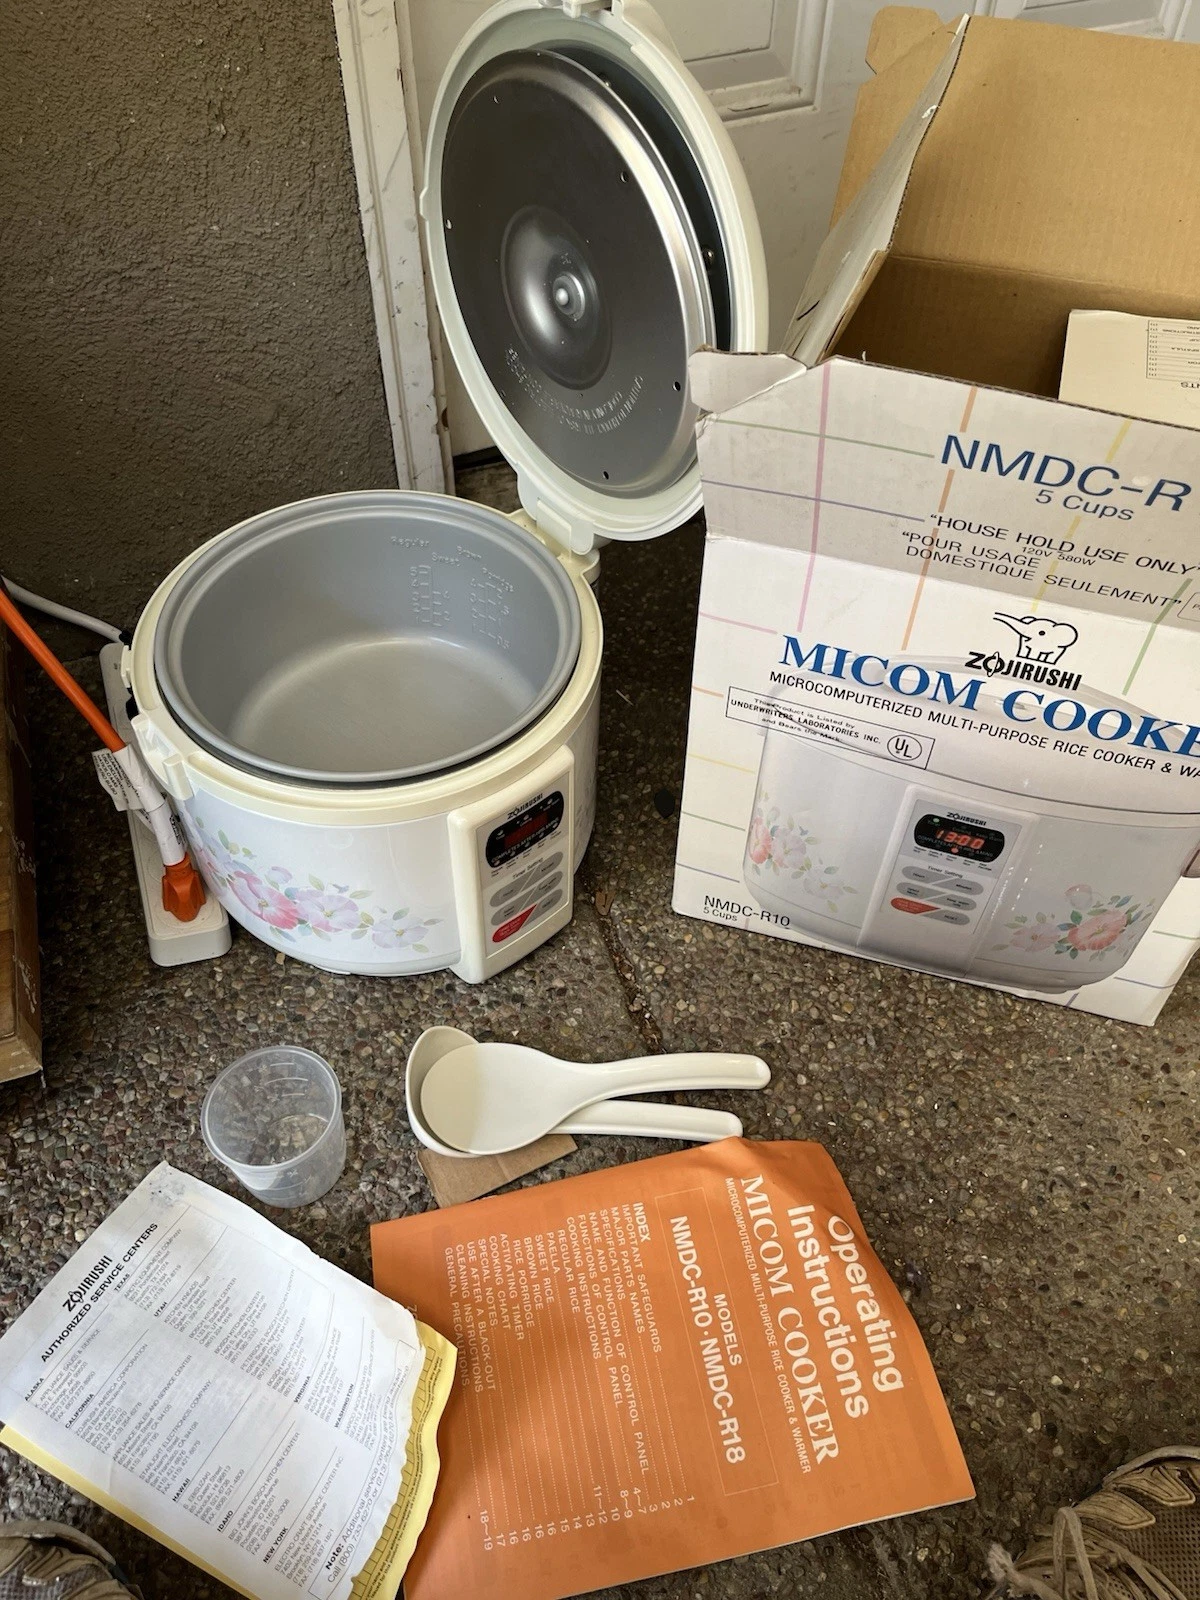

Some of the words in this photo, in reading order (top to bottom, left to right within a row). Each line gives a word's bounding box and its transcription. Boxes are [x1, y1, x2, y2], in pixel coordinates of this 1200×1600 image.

[941, 435, 1192, 512] NMDC-R
[1035, 490, 1052, 504] 5
[1063, 495, 1134, 521] Cups
[906, 545, 1035, 581] DOMESTIQUE
[972, 545, 1041, 568] USAGE
[1016, 532, 1075, 553] HOLD
[1085, 546, 1129, 563] USE
[1022, 547, 1052, 558] 120V
[1058, 554, 1096, 566] 580W
[778, 634, 987, 711] MICOM
[965, 651, 1082, 691] ZOJIRUSHI
[731, 700, 793, 720] UNDERWRITERS
[797, 717, 859, 738] LABORATORIES
[864, 735, 881, 744] INC.
[770, 671, 922, 718] MICROCOMPUTERIZED
[928, 711, 1049, 748] MULTI-PURPOSE
[1053, 740, 1088, 757] RICE
[1093, 749, 1156, 770] COOKER
[1161, 762, 1172, 774] &
[895, 738, 912, 758] UL
[507, 793, 543, 819] ZOJIRUSHI
[704, 895, 790, 926] NMDC-R10
[712, 909, 737, 921] Cups
[632, 1202, 650, 1242] INDEX
[724, 1177, 757, 1270] MICROCOMPUTERIZED
[466, 1241, 476, 1262] USE
[512, 1239, 523, 1264] RICE
[546, 1231, 560, 1273] PAELLA
[577, 1214, 597, 1278] FUNCTIONS
[39, 1302, 92, 1362] AUTHORIZED
[89, 1262, 124, 1302] SERVICE
[121, 1222, 158, 1263] CENTERS
[61, 1254, 113, 1312] ZOJIRUSHI
[113, 1273, 130, 1291] TEXAS
[470, 1266, 482, 1303] AFTER
[517, 1269, 534, 1327] PORRIDGE
[566, 1216, 583, 1267] COOKING
[577, 1272, 601, 1359] INSTRUCTIONS
[591, 1283, 601, 1299] OF
[621, 1204, 642, 1269] IMPORTANT
[637, 1274, 661, 1352] SAFEGUARDS
[153, 1301, 167, 1317] UTAH
[444, 1247, 457, 1296] GENERAL
[451, 1301, 469, 1386] PRECAUTIONS
[475, 1307, 484, 1316] A
[739, 1174, 793, 1297] MICOM
[773, 1305, 843, 1464] COOKER
[749, 1272, 778, 1347] MULTI-PURPOSE
[786, 1204, 873, 1419] Instructions
[823, 1214, 906, 1394] Operating
[595, 1304, 613, 1361] CONTROL
[669, 1216, 713, 1327] NMDC-R10
[697, 1338, 746, 1464] NMDC-R18
[712, 1293, 742, 1366] MODELS
[478, 1321, 495, 1391] BLACK-OUT
[557, 1229, 574, 1282] REGULAR
[568, 1287, 580, 1313] RICE
[609, 1507, 620, 1521] 10
[588, 1212, 601, 1243] NAME
[595, 1248, 607, 1272] AND
[602, 1277, 621, 1337] FUNCTION
[615, 1342, 625, 1359] OF
[620, 1364, 639, 1426] CONTROL
[633, 1431, 649, 1474] PANEL
[648, 1503, 657, 1512] 3
[599, 1209, 625, 1300] SPECIFICATIONS
[660, 1500, 670, 1509] 2
[610, 1206, 626, 1245] MAJOR
[620, 1250, 635, 1287] PARTS
[628, 1292, 645, 1333] NAMES
[673, 1497, 683, 1506] 2
[770, 1349, 784, 1371] RICE
[23, 1377, 44, 1401] ALASKA
[293, 1375, 311, 1403] VIRGINIA
[455, 1244, 469, 1298] CLEANING
[463, 1303, 482, 1392] INSTRUCTIONS
[495, 1532, 505, 1547] 17
[477, 1238, 491, 1282] SPECIAL
[521, 1526, 531, 1541] 16
[488, 1235, 503, 1285] COOKING
[497, 1290, 510, 1330] CHART
[534, 1523, 544, 1538] 16
[499, 1232, 517, 1298] ACTIVATING
[511, 1304, 524, 1340] TIMER
[546, 1521, 556, 1535] 16
[523, 1236, 537, 1278] BROWN
[531, 1284, 543, 1310] RICE
[572, 1515, 582, 1529] 14
[534, 1234, 548, 1271] SWEET
[542, 1277, 554, 1303] RICE
[584, 1512, 594, 1527] 13
[608, 1367, 623, 1408] PANEL
[776, 1373, 796, 1413] COOKER
[64, 1392, 94, 1429] CALIFORNIA
[333, 1382, 355, 1428] WASHINGTON
[787, 1416, 799, 1424] &
[790, 1427, 812, 1473] WARMER
[172, 1477, 190, 1502] HAWAII
[216, 1509, 233, 1532] IDAHO
[325, 1543, 345, 1570] Note:
[342, 1502, 366, 1543] Additional
[364, 1467, 378, 1499] service
[327, 1561, 341, 1583] Call
[338, 1543, 355, 1569] (800)
[371, 1486, 379, 1497] or
[508, 1530, 518, 1544] 16
[559, 1518, 569, 1532] 15
[262, 1546, 275, 1563] NEW
[273, 1525, 288, 1547] YORK
